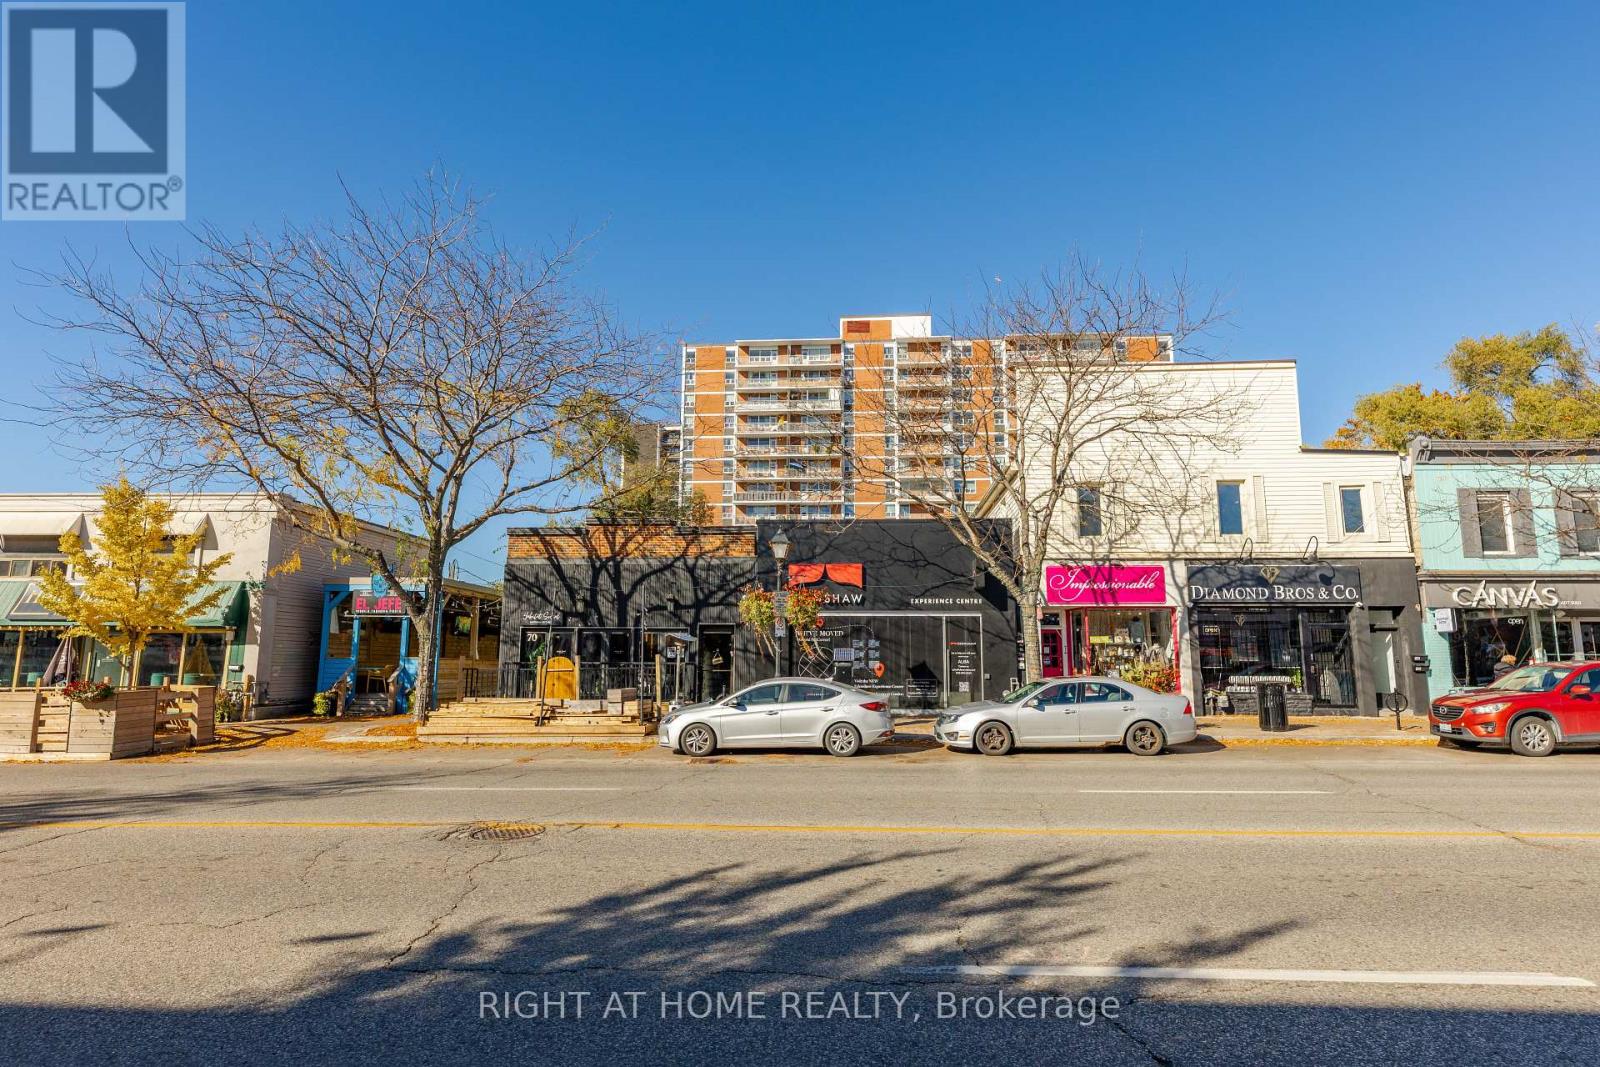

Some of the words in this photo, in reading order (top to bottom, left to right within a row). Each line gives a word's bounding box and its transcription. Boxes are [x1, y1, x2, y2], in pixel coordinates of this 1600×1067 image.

[1049, 568, 1160, 602] Impressionable
[816, 593, 863, 604] SHAW
[1318, 587, 1330, 600] &
[1452, 579, 1560, 608] CANVAS
[355, 596, 367, 610] EL
[375, 596, 402, 610] JEFE
[1507, 618, 1524, 626] open
[527, 633, 538, 642] 70
